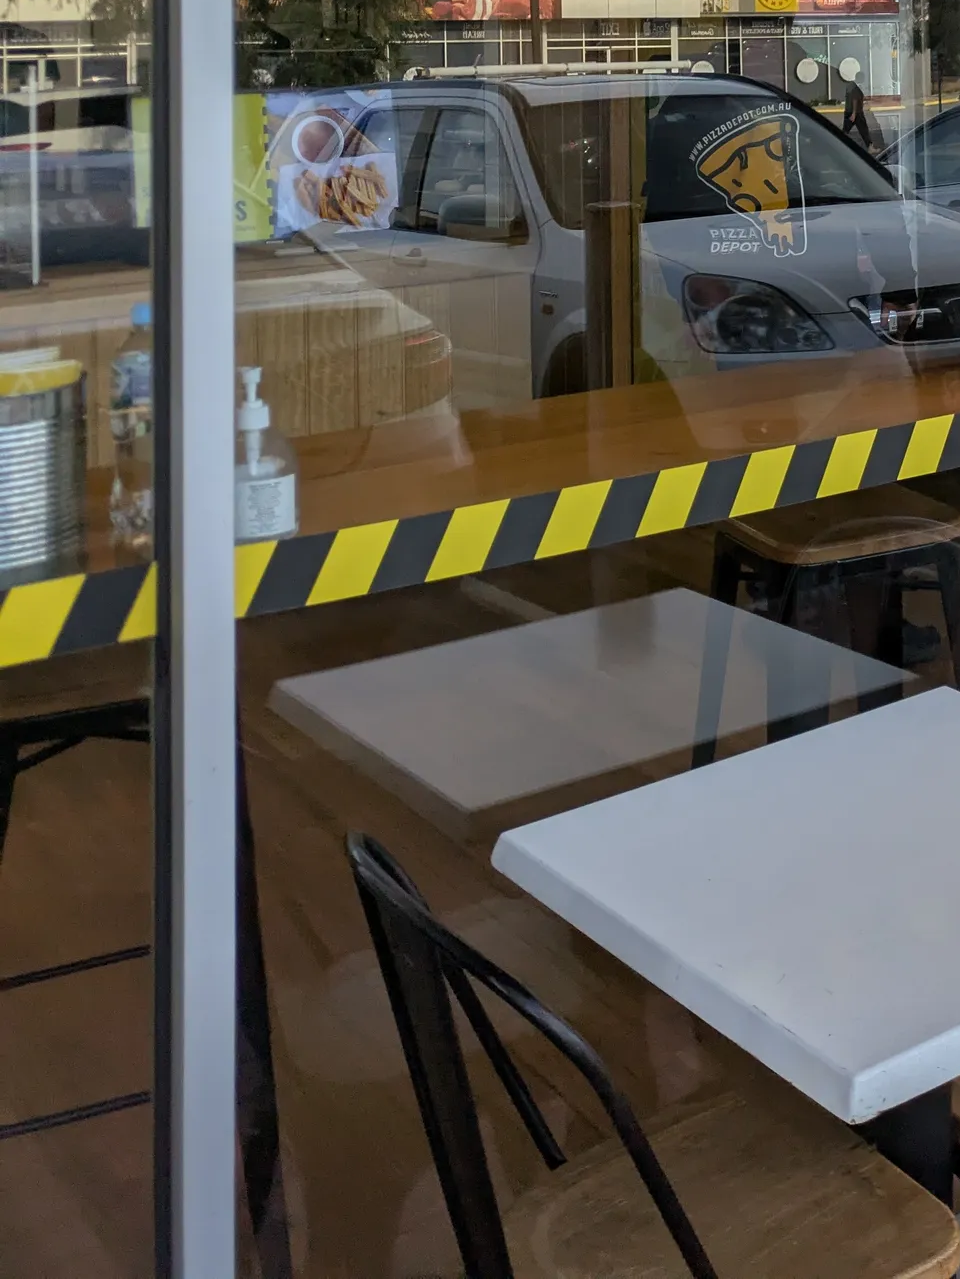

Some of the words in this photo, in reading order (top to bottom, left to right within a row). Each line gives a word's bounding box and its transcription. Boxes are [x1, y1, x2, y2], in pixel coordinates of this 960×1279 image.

[688, 102, 793, 162] WWW.PIZZADEPOT.COM.AU
[709, 228, 758, 240] PIZZA
[710, 241, 762, 254] DEPOT
